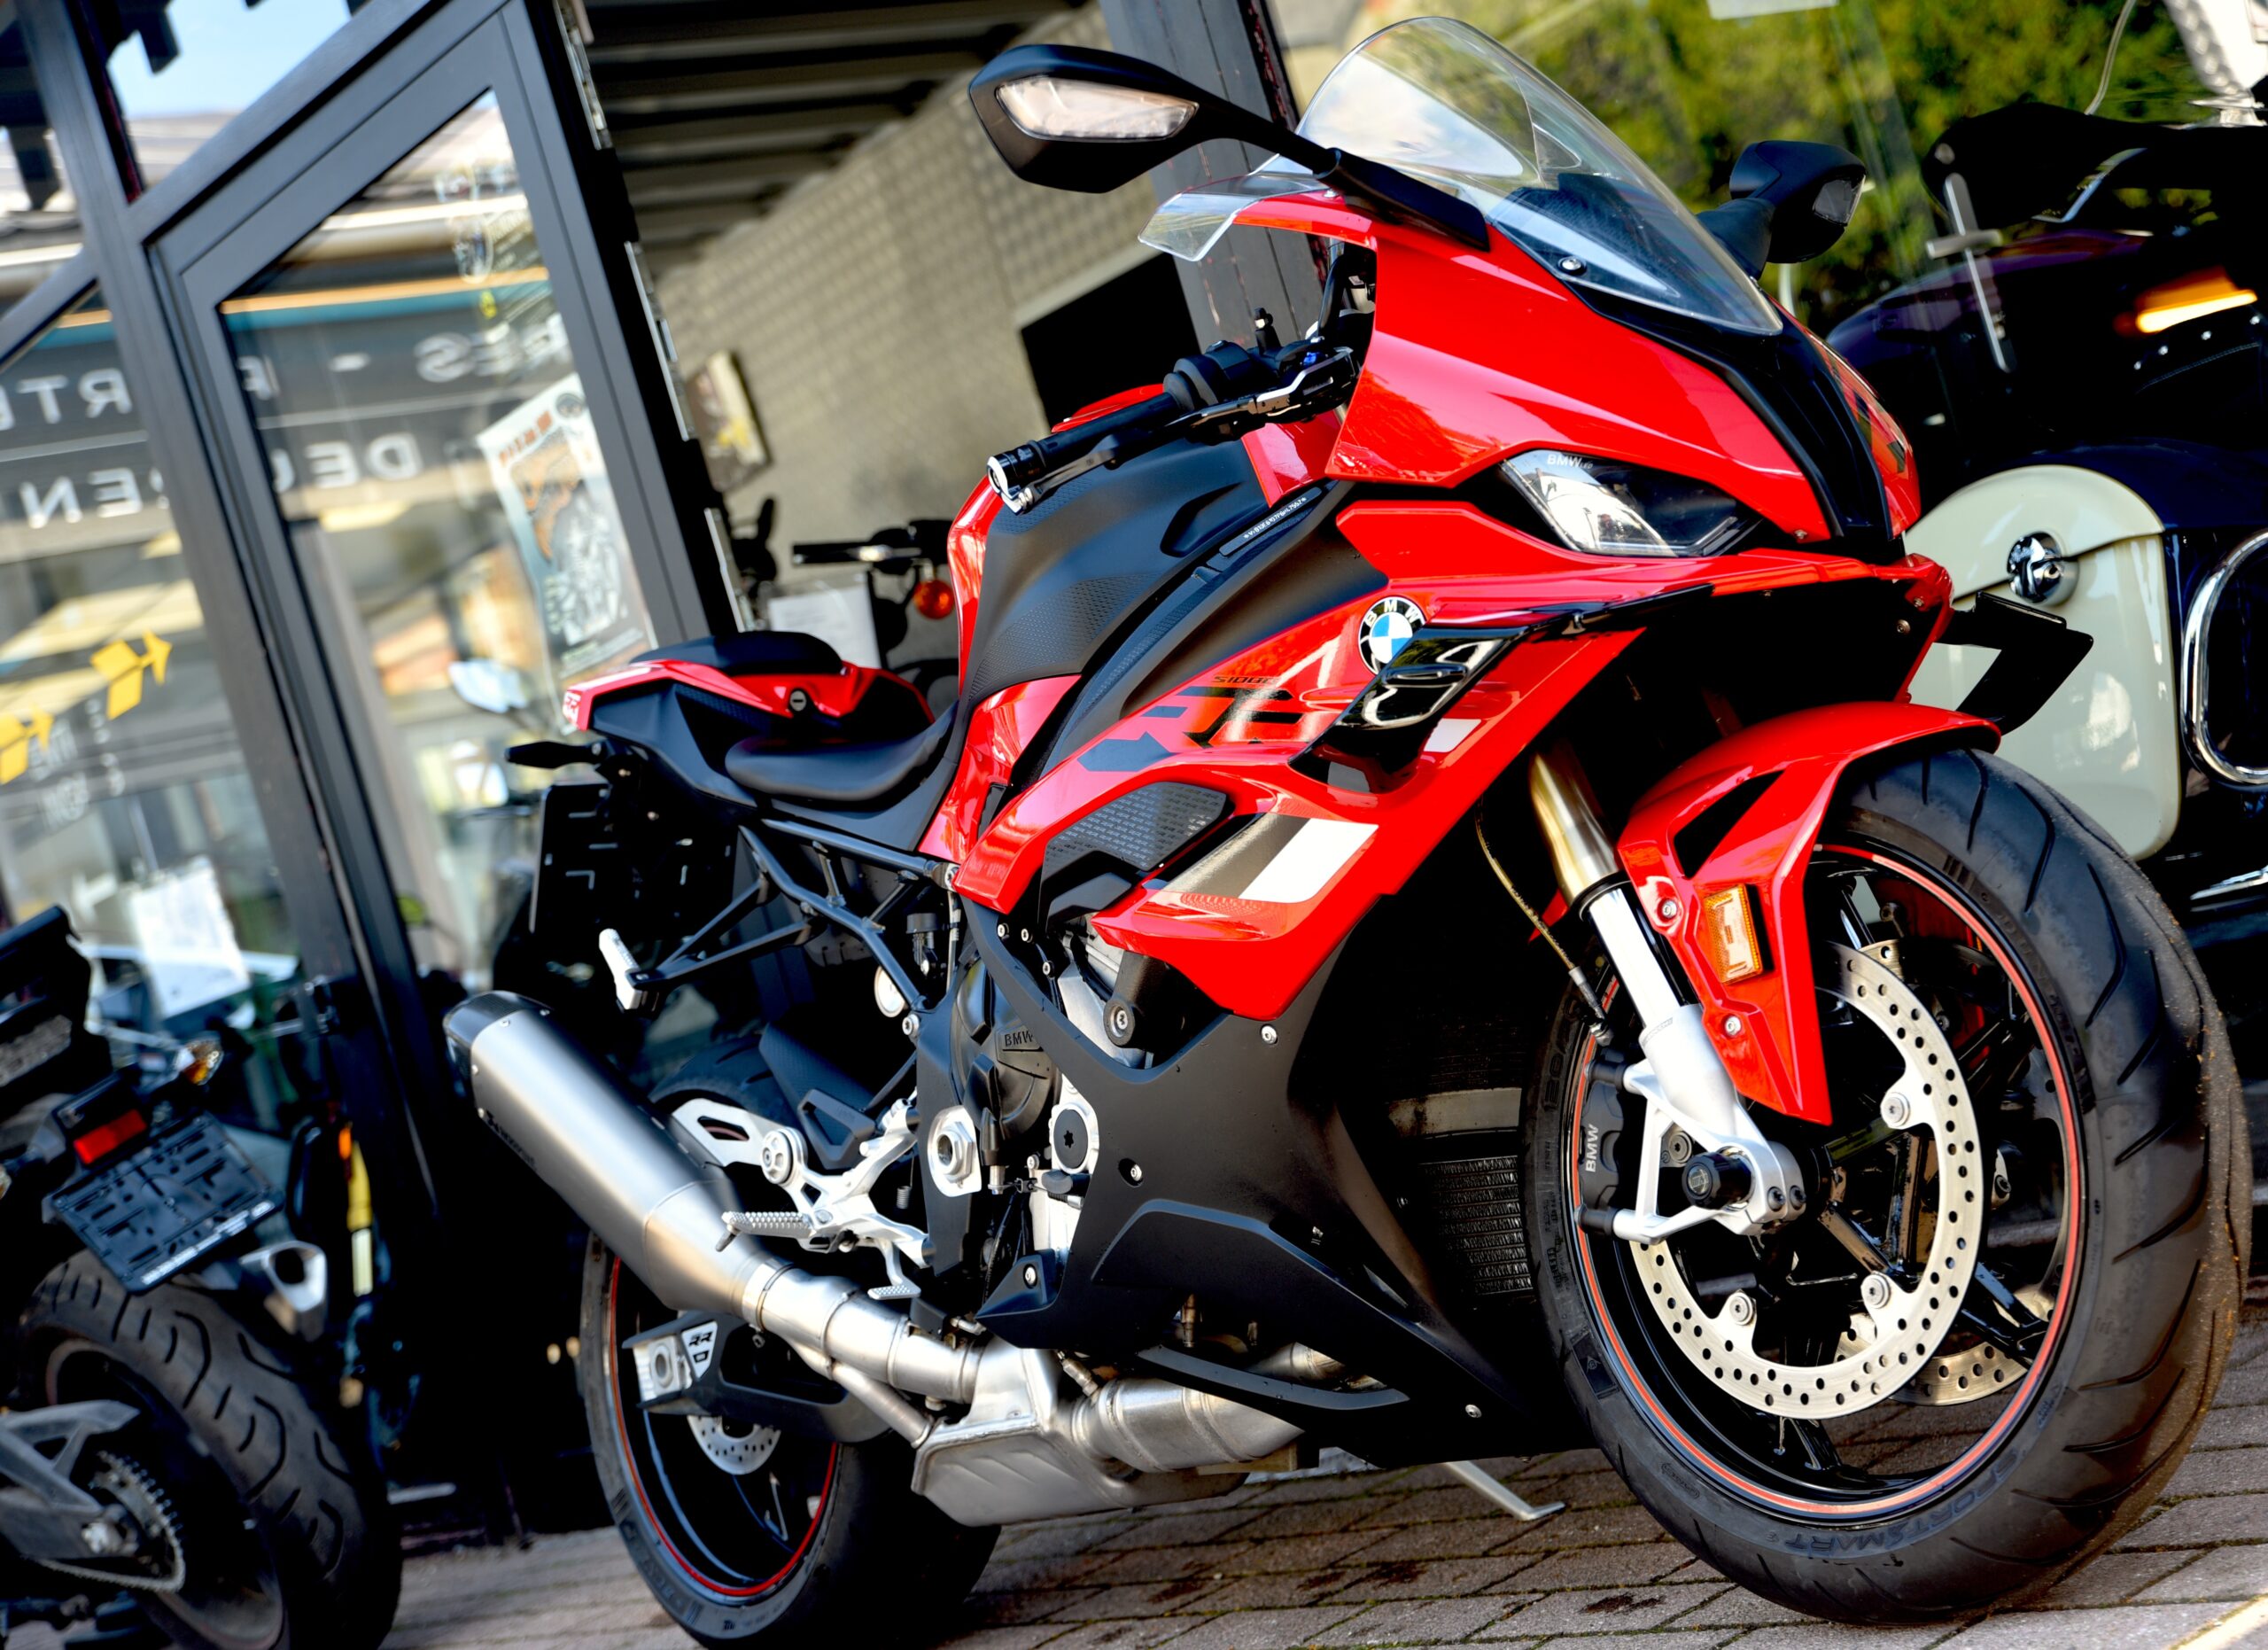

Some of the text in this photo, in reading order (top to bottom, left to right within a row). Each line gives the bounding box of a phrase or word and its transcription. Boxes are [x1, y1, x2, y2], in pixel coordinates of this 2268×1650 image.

[1547, 454, 1582, 468] BMW
[1364, 599, 1421, 627] BMW
[1005, 1028, 1034, 1047] BMW
[1585, 1123, 1599, 1172] BMW
